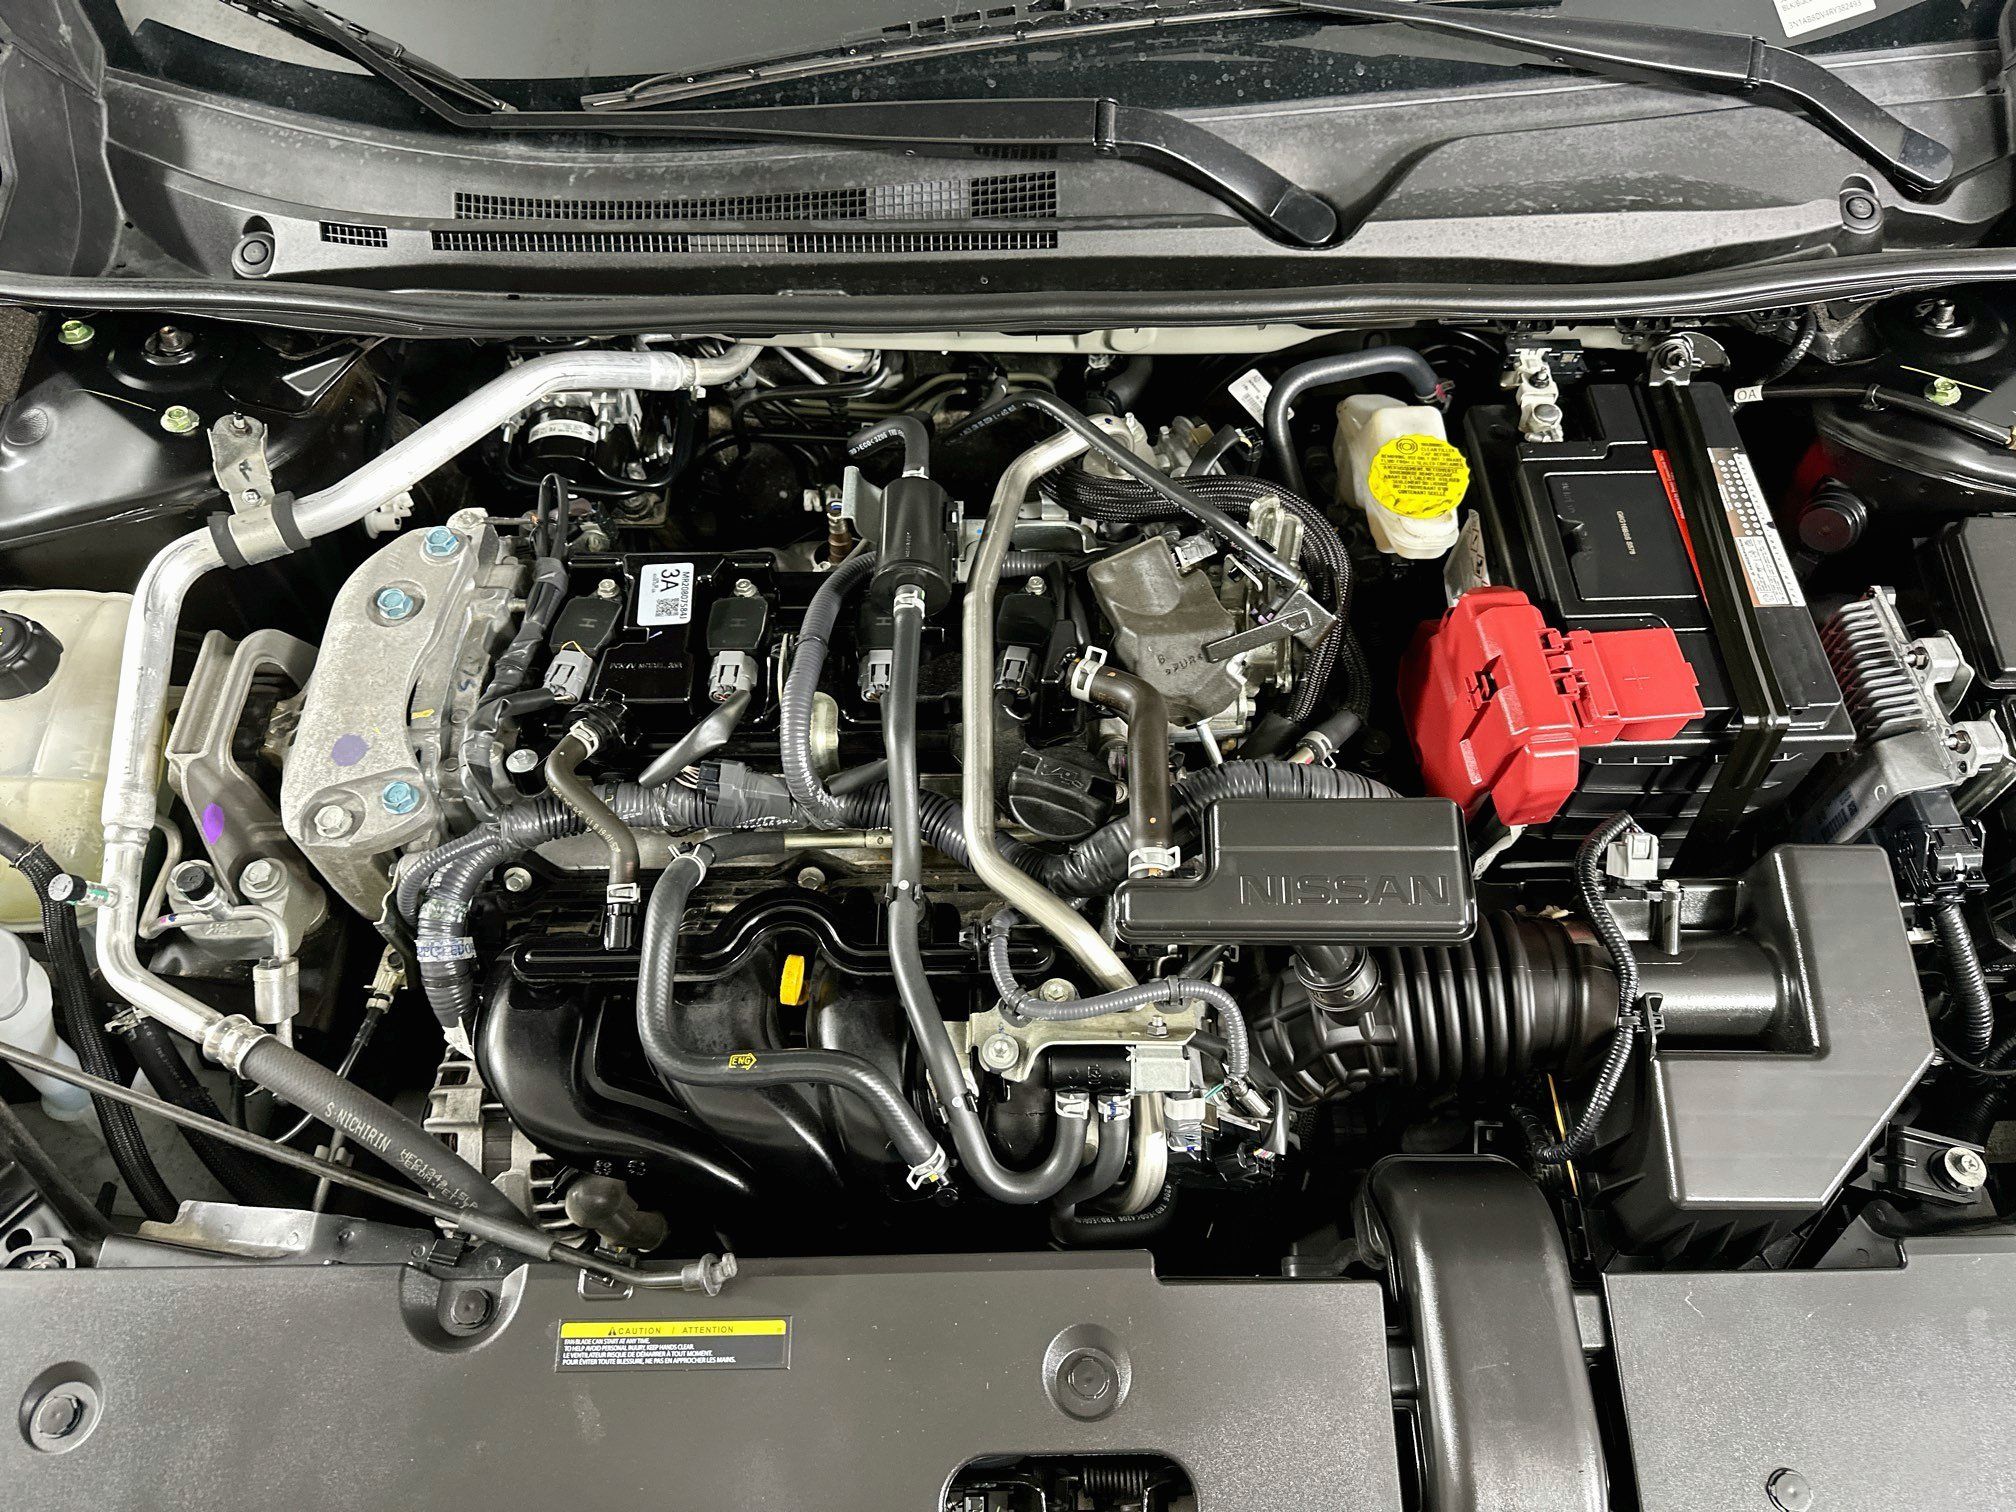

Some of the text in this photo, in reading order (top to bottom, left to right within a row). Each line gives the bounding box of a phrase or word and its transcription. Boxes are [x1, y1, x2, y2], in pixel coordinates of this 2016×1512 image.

[660, 568, 681, 592] 3A
[1239, 873, 1451, 905] NISSAN
[732, 1056, 751, 1065] ENG
[618, 1327, 661, 1335] CAUTION
[682, 1326, 734, 1334] ATTENTION
